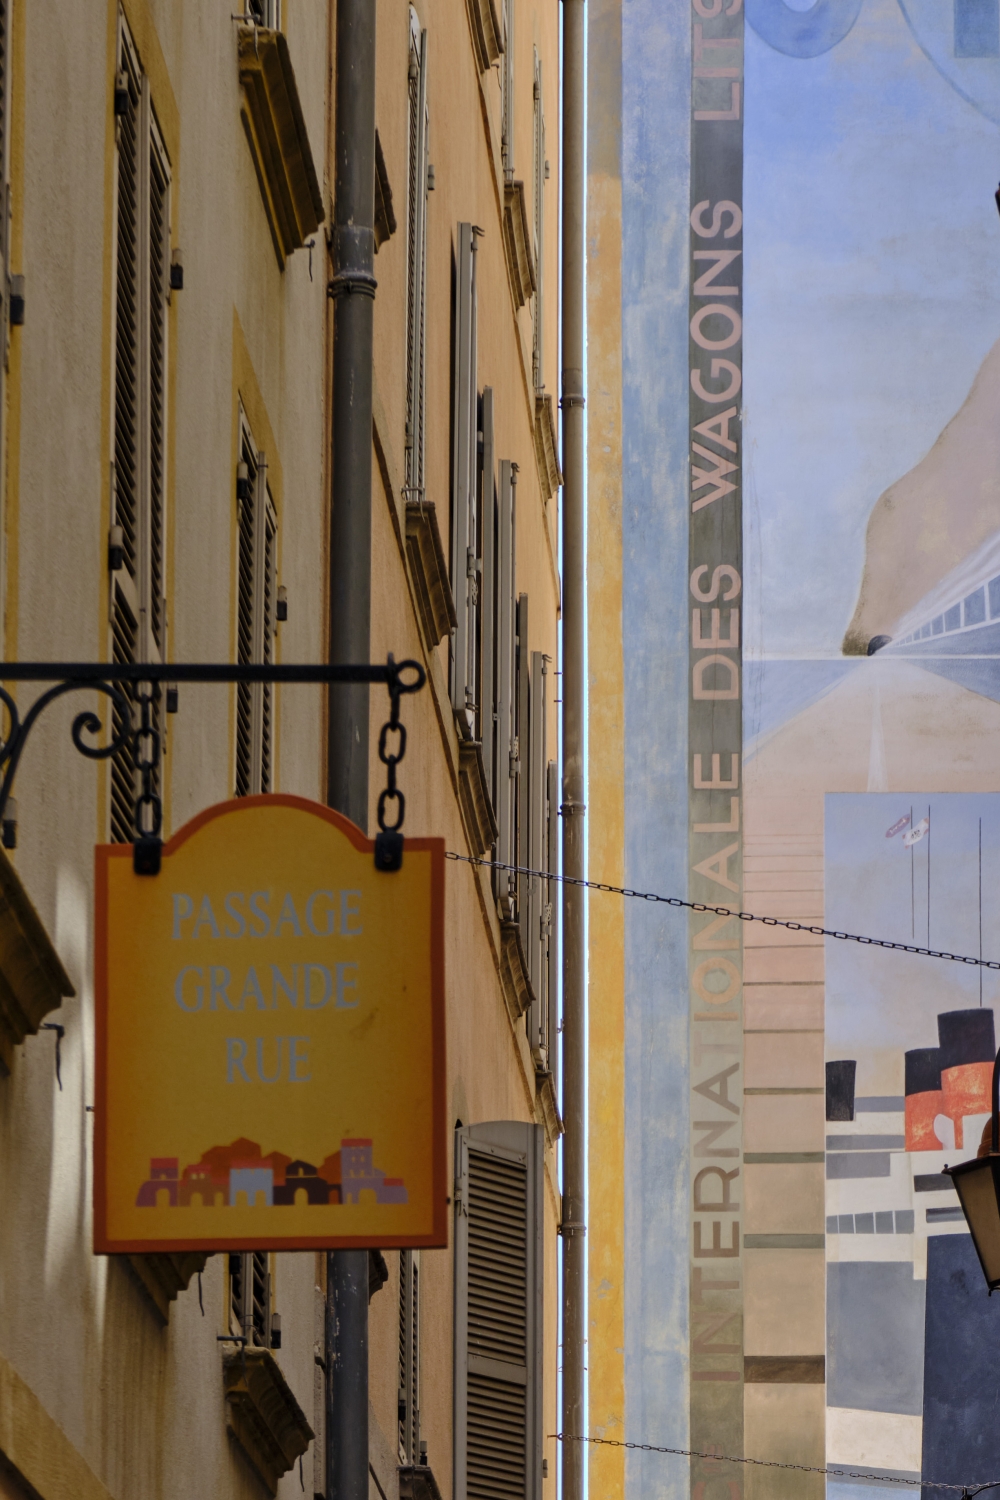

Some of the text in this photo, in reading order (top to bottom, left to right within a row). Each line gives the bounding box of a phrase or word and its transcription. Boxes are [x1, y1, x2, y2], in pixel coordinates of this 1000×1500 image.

[690, 199, 743, 514] WAGONS
[690, 564, 742, 700] DES
[171, 889, 363, 940] PASSAGE
[174, 962, 360, 1012] GRANDE
[225, 1036, 312, 1083] RUE
[692, 752, 741, 1382] INTERNATIONALE
